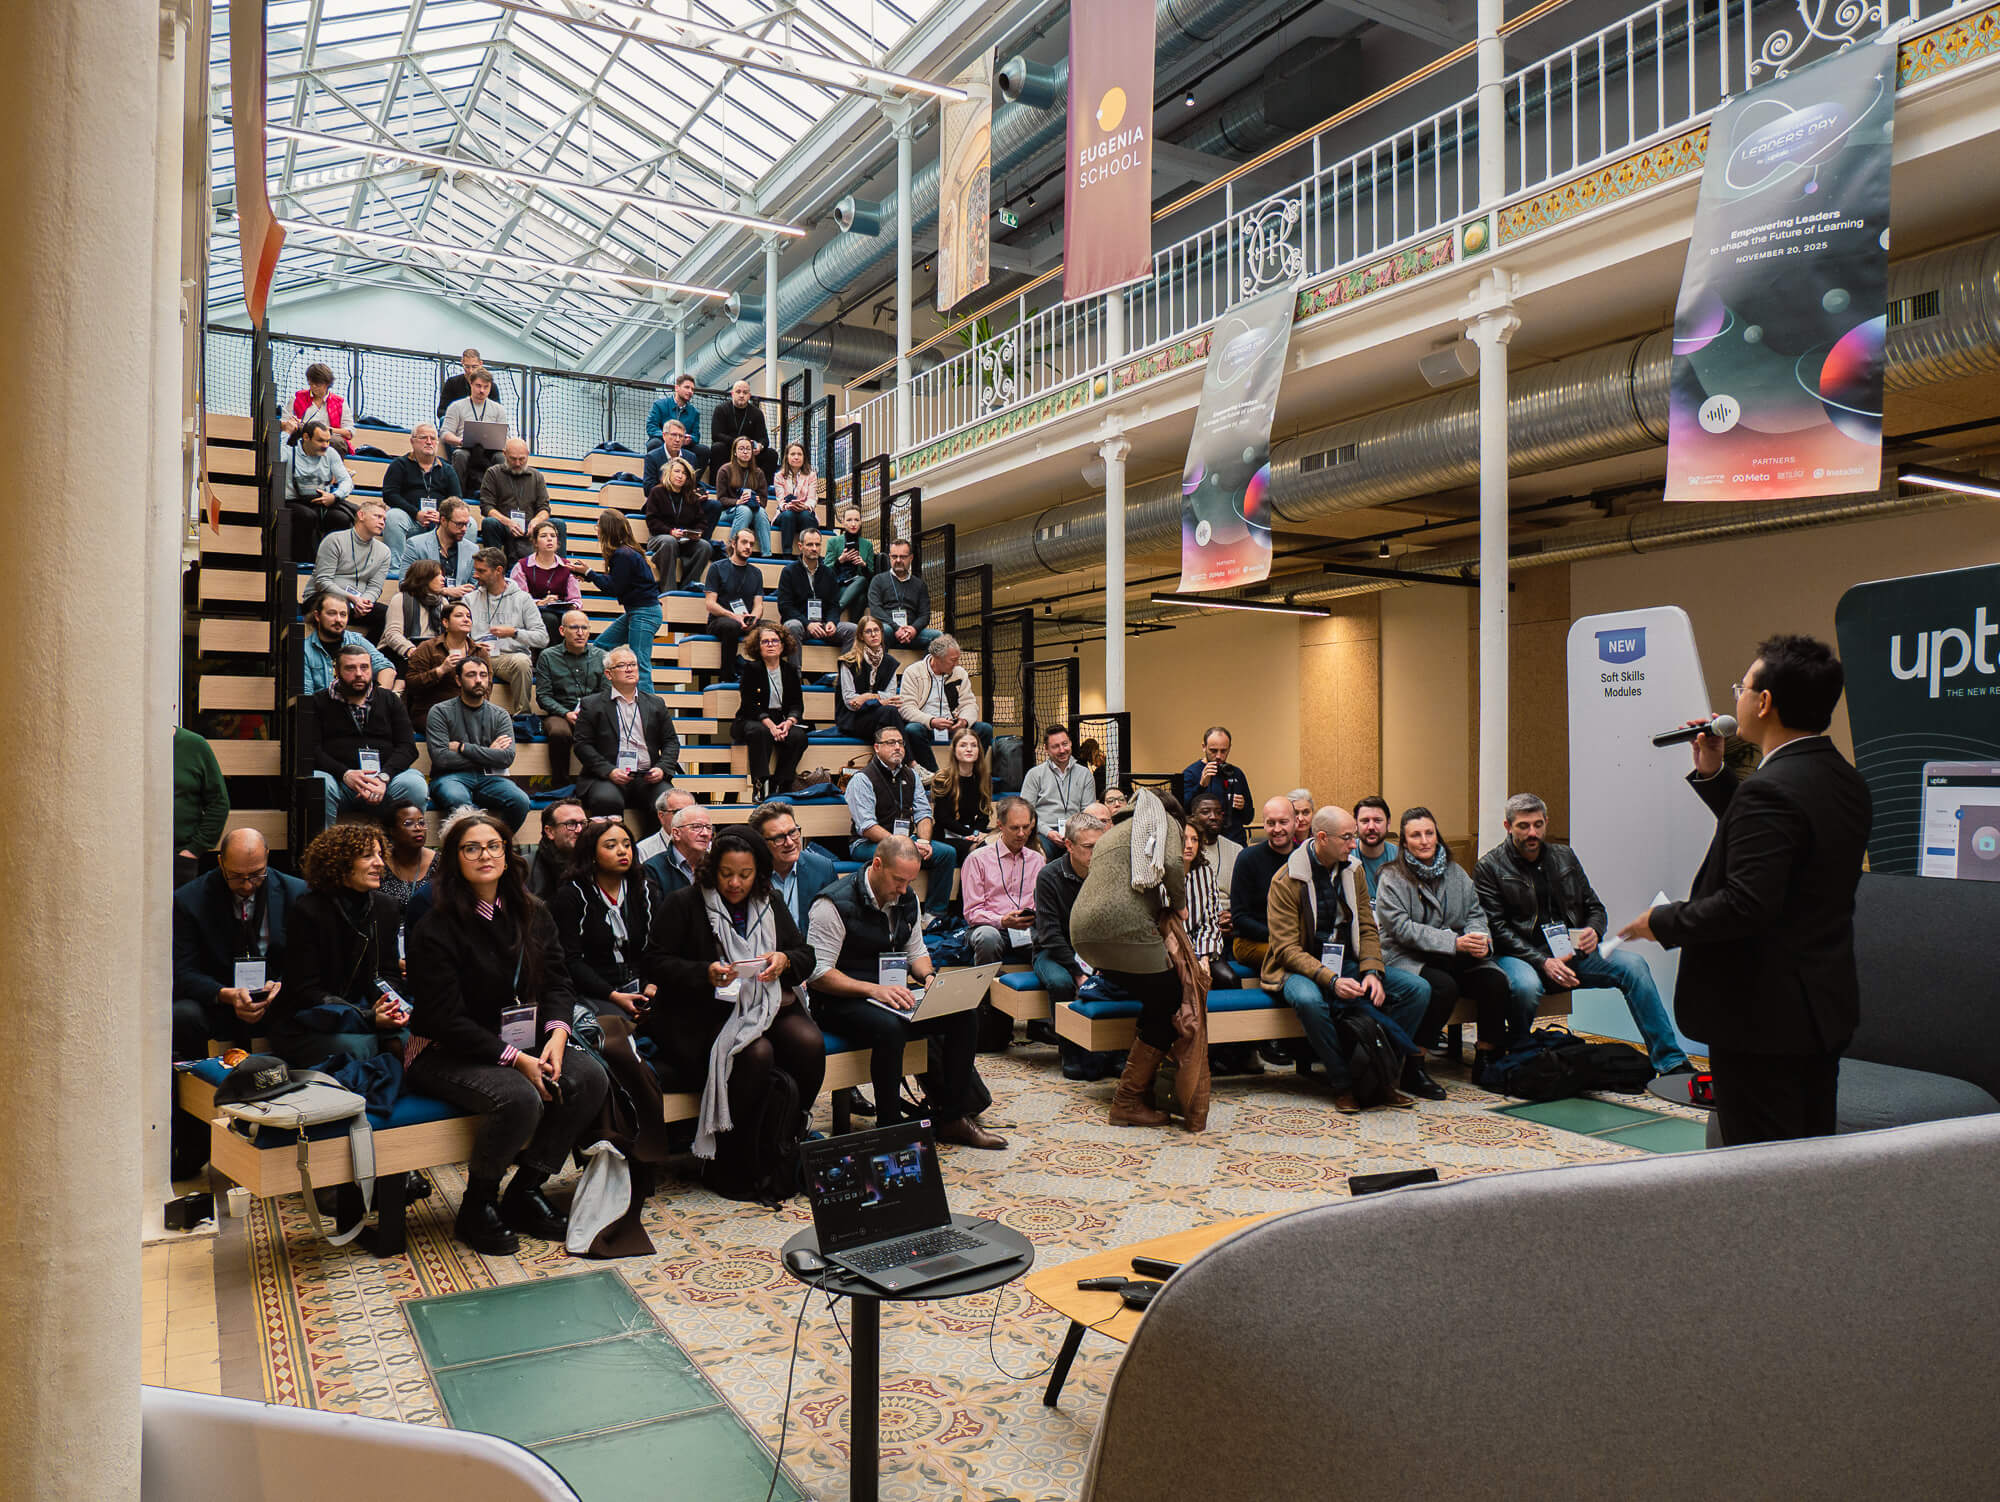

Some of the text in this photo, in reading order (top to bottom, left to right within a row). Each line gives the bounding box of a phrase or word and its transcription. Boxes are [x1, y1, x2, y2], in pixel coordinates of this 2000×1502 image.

[1080, 126, 1144, 167] EUGENIA
[1742, 129, 1805, 160] LEADERS
[1808, 115, 1839, 136] DAY
[1080, 150, 1142, 189] SCHOOL
[1710, 218, 1864, 255] to shape the Future of Learning
[1730, 210, 1841, 240] Empowering Leaders
[1736, 246, 1784, 264] NOVEMBER
[1803, 241, 1829, 252] 2025
[1752, 456, 1796, 466] PARTNERS
[1745, 473, 1770, 482] Meta
[1608, 639, 1636, 653] NEW
[1891, 606, 2000, 698] upt
[1600, 670, 1645, 683] Soft Skills
[1604, 686, 1642, 698] Modules
[1945, 688, 1964, 697] THE
[1967, 687, 1986, 697] NEW
